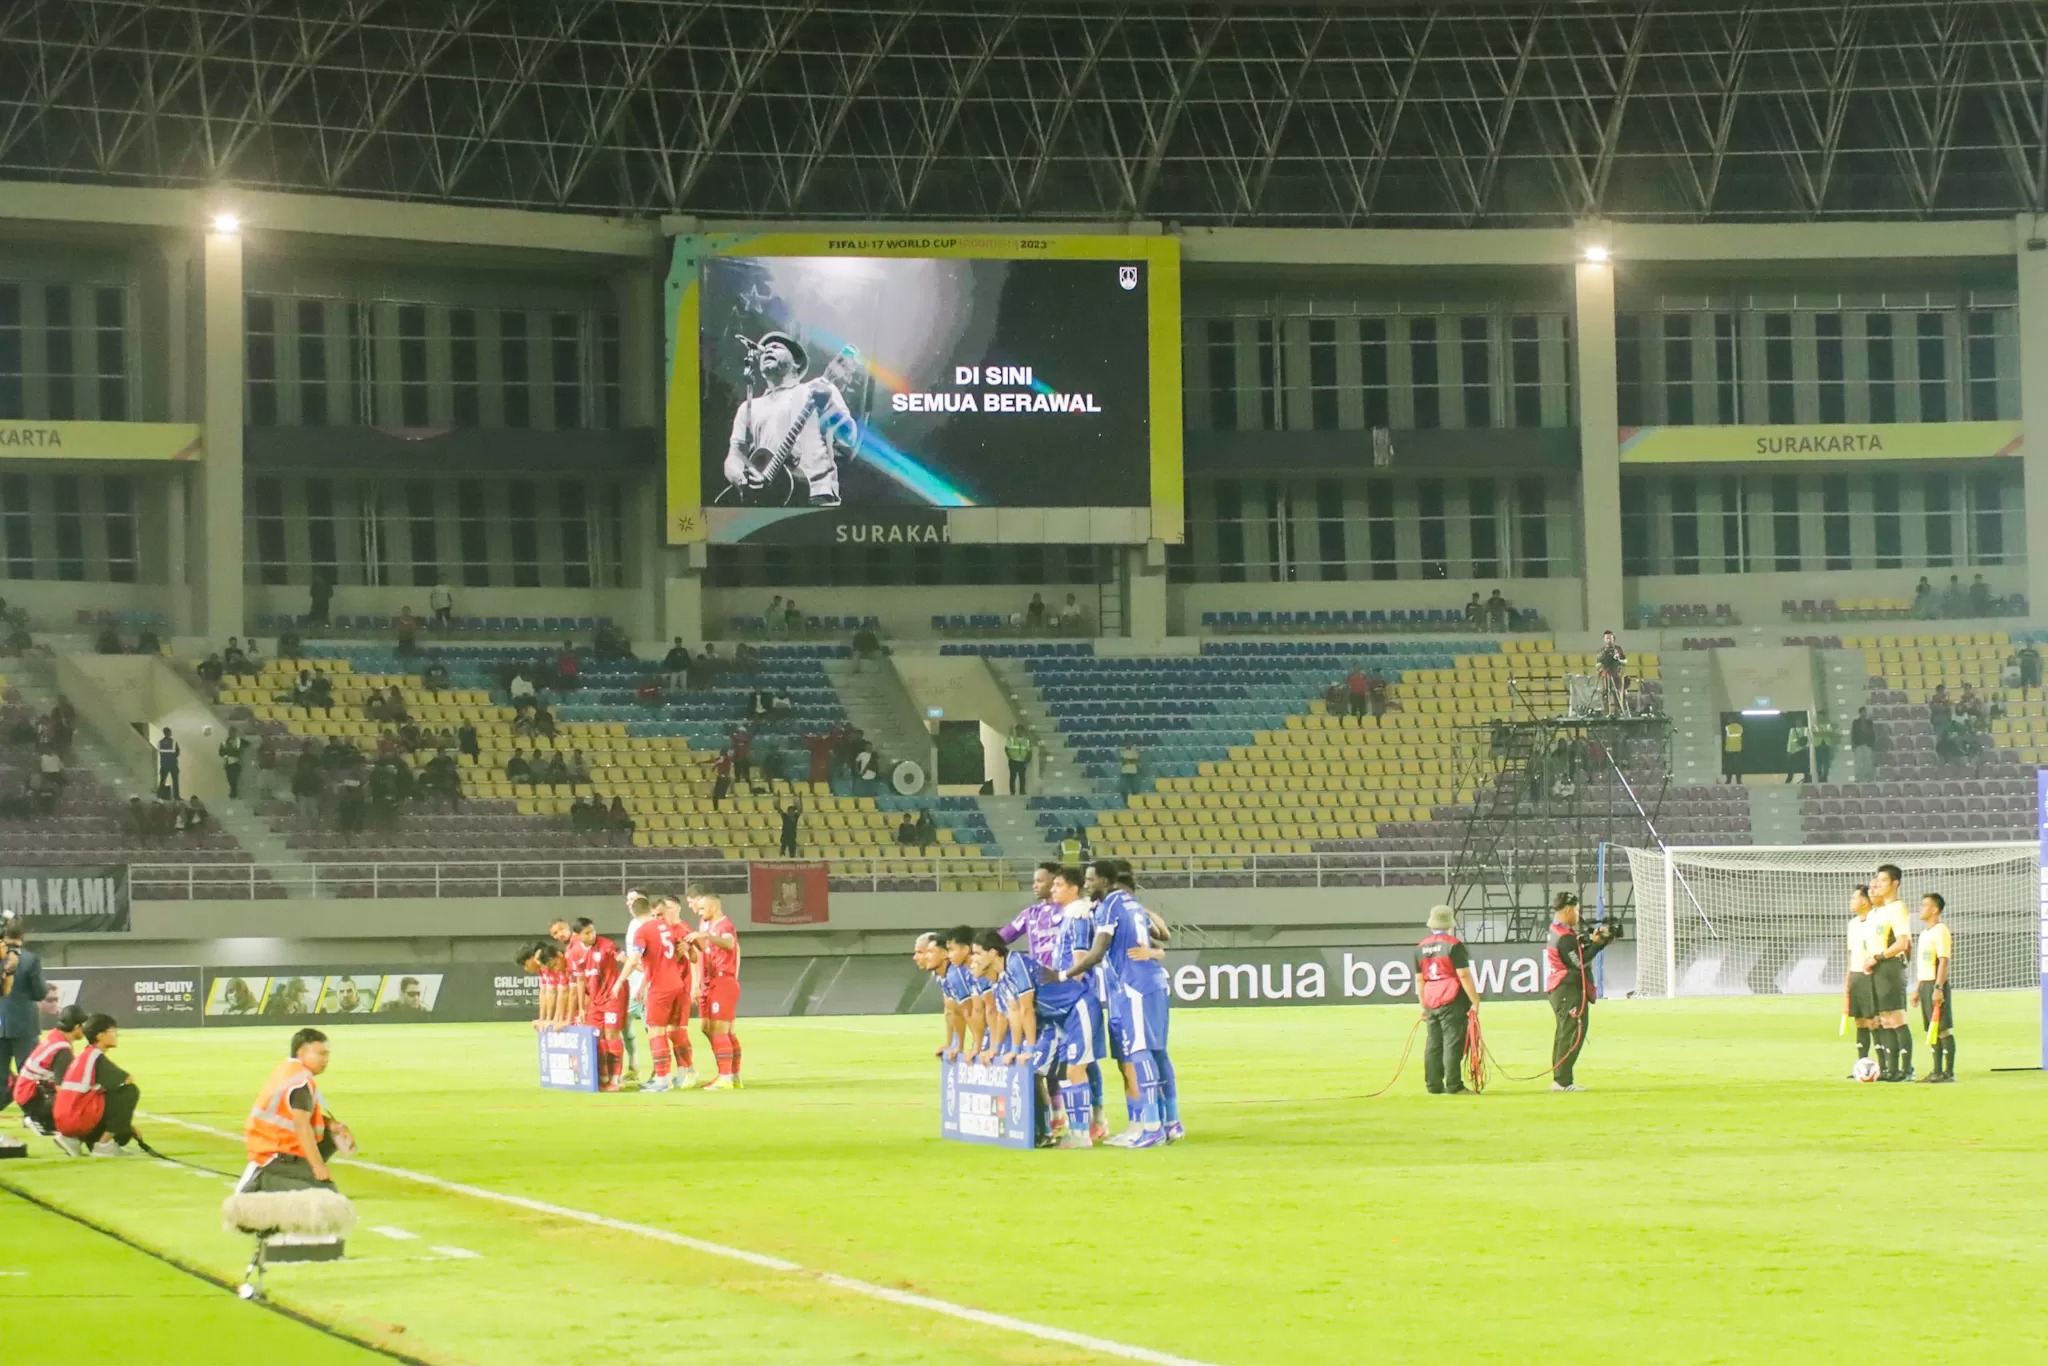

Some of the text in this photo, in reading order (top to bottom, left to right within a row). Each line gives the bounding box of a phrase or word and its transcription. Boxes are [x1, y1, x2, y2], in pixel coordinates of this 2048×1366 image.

[828, 239, 856, 250] FIFA
[886, 239, 930, 250] WORLD
[933, 239, 957, 249] CUP
[1020, 238, 1048, 250] 2023
[955, 366, 1032, 385] DI SINI
[892, 393, 1102, 412] SEMUA BERAWAL
[1756, 434, 1883, 454] SURAKARTA
[47, 877, 116, 915] KAMI
[135, 981, 160, 994] CALL
[165, 981, 193, 993] DUTY
[494, 976, 519, 988] CALL
[136, 994, 182, 1002] MOBILE
[495, 989, 540, 997] MOBILE
